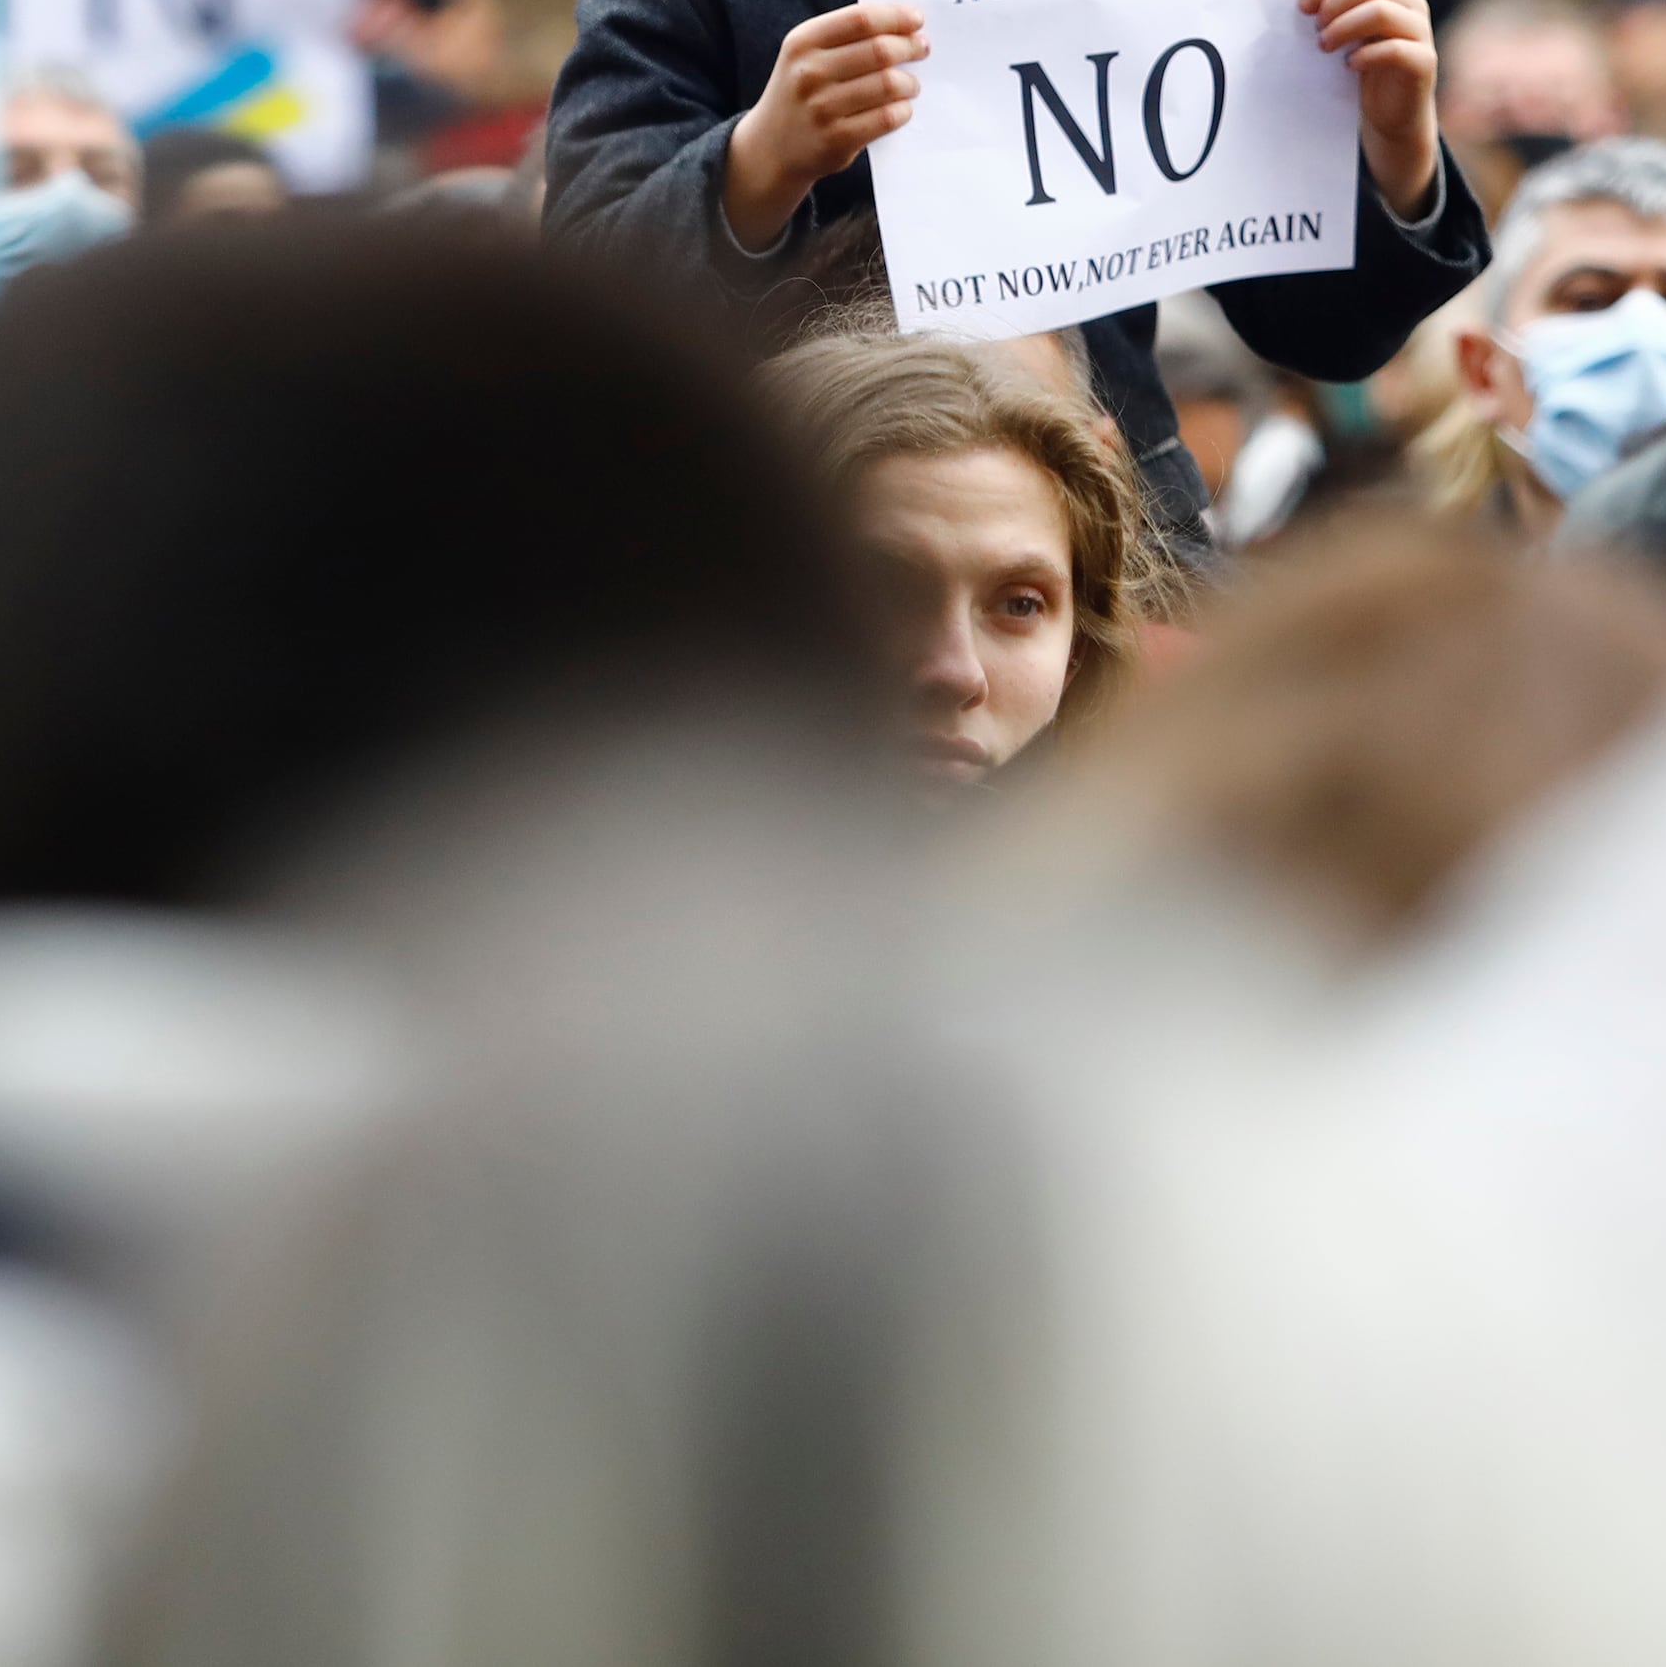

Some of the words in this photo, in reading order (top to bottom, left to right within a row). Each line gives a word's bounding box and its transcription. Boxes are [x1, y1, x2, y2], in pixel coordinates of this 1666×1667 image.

[1009, 37, 1226, 206] NO
[915, 274, 986, 312] NOT
[1146, 227, 1210, 271] EVER
[1216, 212, 1323, 251] AGAIN
